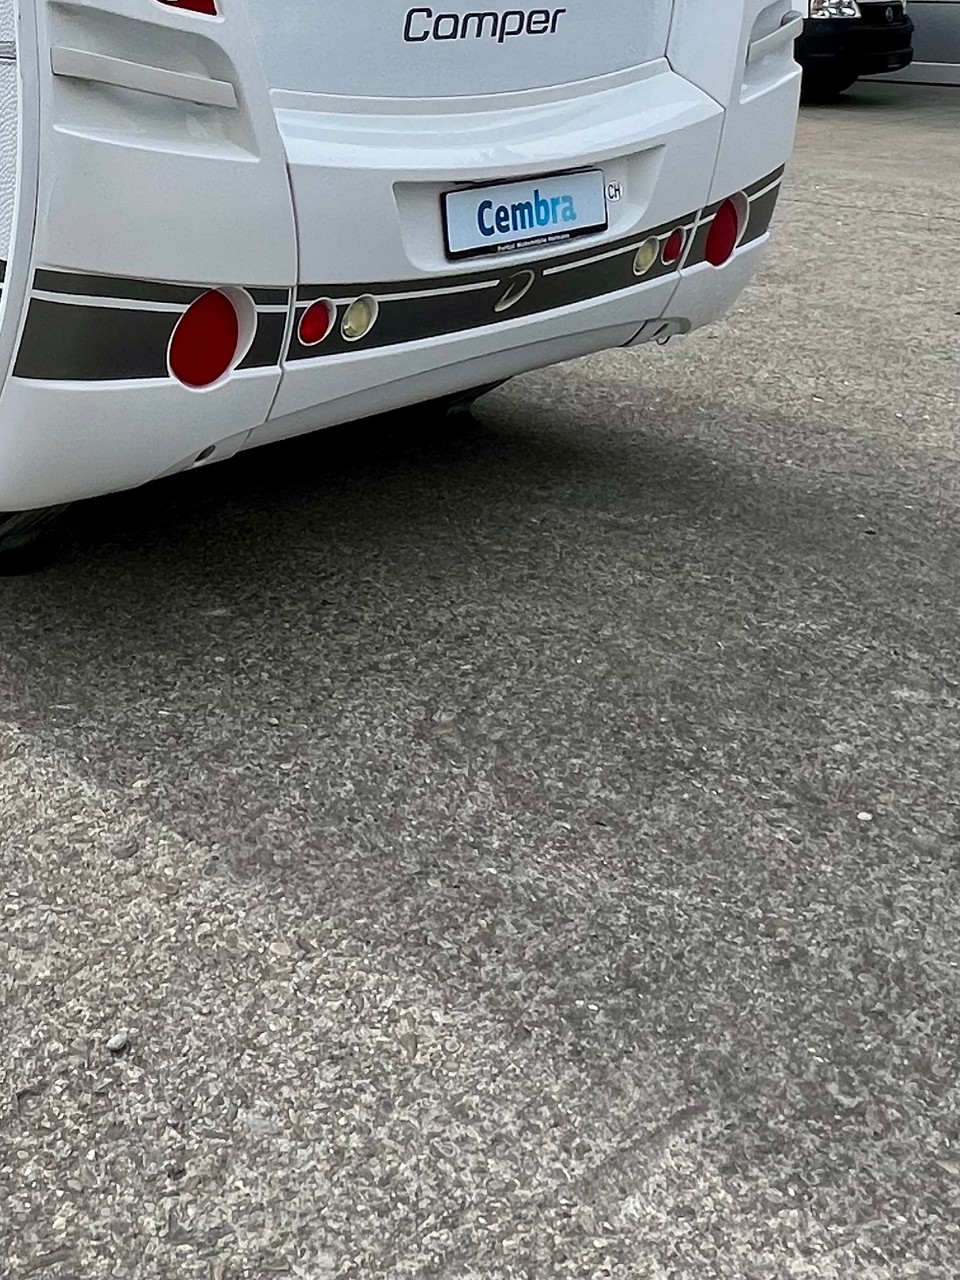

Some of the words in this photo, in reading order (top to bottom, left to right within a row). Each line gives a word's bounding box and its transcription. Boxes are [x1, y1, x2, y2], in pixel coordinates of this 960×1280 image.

[403, 7, 567, 43] Camper
[608, 184, 621, 199] CH
[477, 189, 577, 237] Cembra
